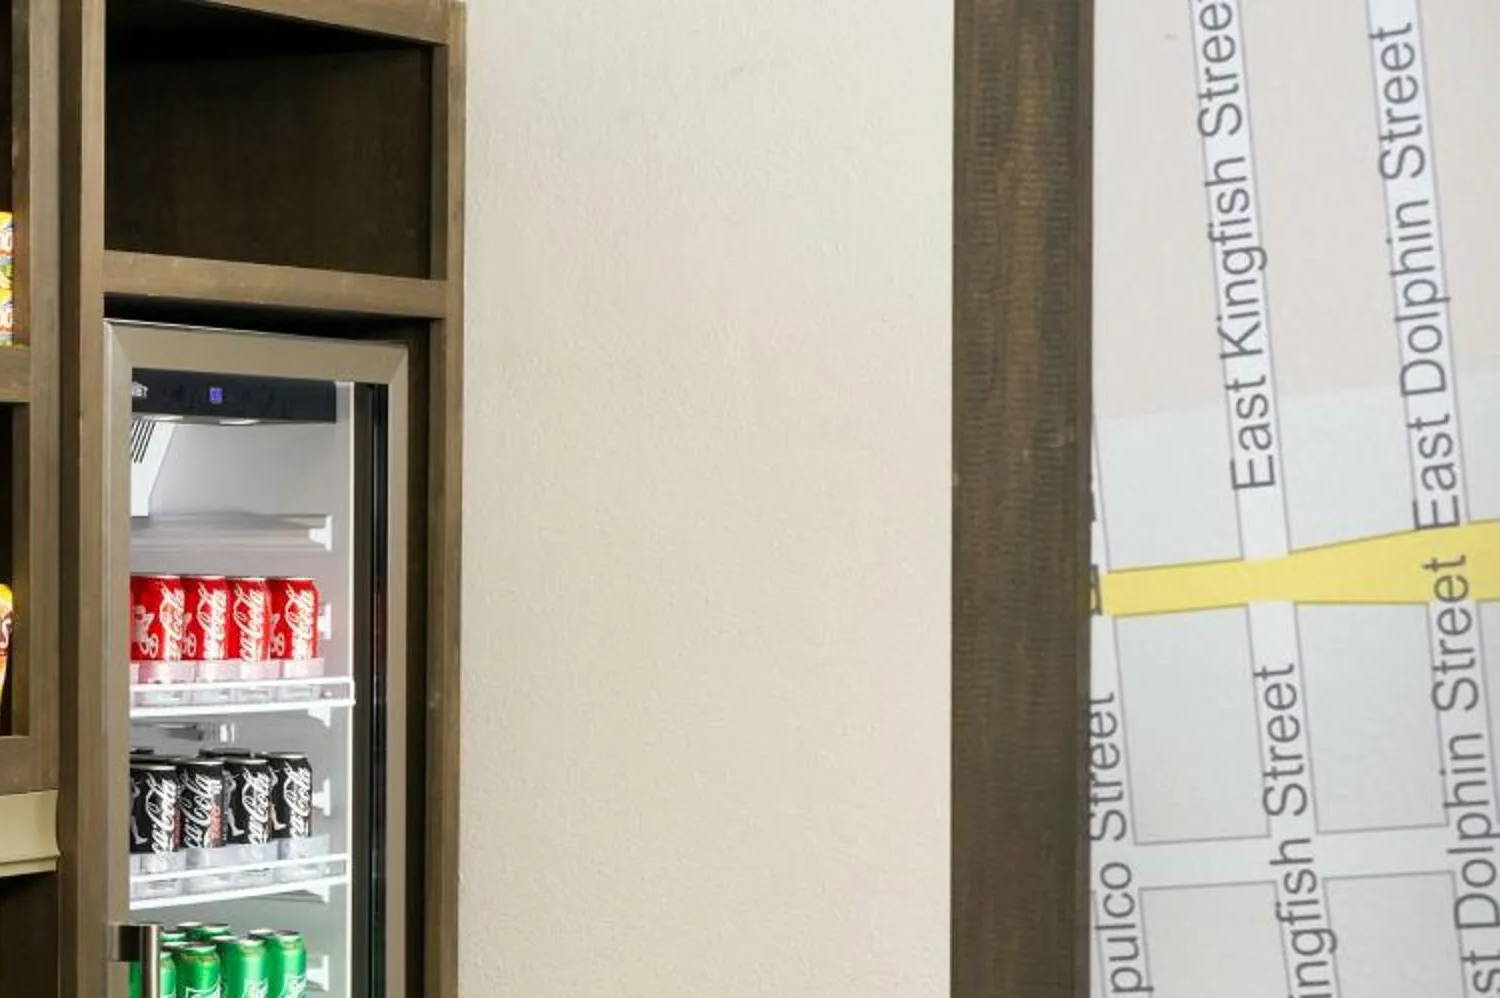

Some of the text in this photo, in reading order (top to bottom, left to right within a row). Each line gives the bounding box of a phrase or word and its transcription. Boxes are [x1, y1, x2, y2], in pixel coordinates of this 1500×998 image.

[1198, 0, 1276, 491] East Kingfish Stree
[1369, 22, 1460, 531] East Dolphin Street
[1421, 554, 1479, 712] Street
[1089, 691, 1127, 844] Street
[1254, 663, 1308, 819] Street
[1439, 731, 1500, 930] Dolphin
